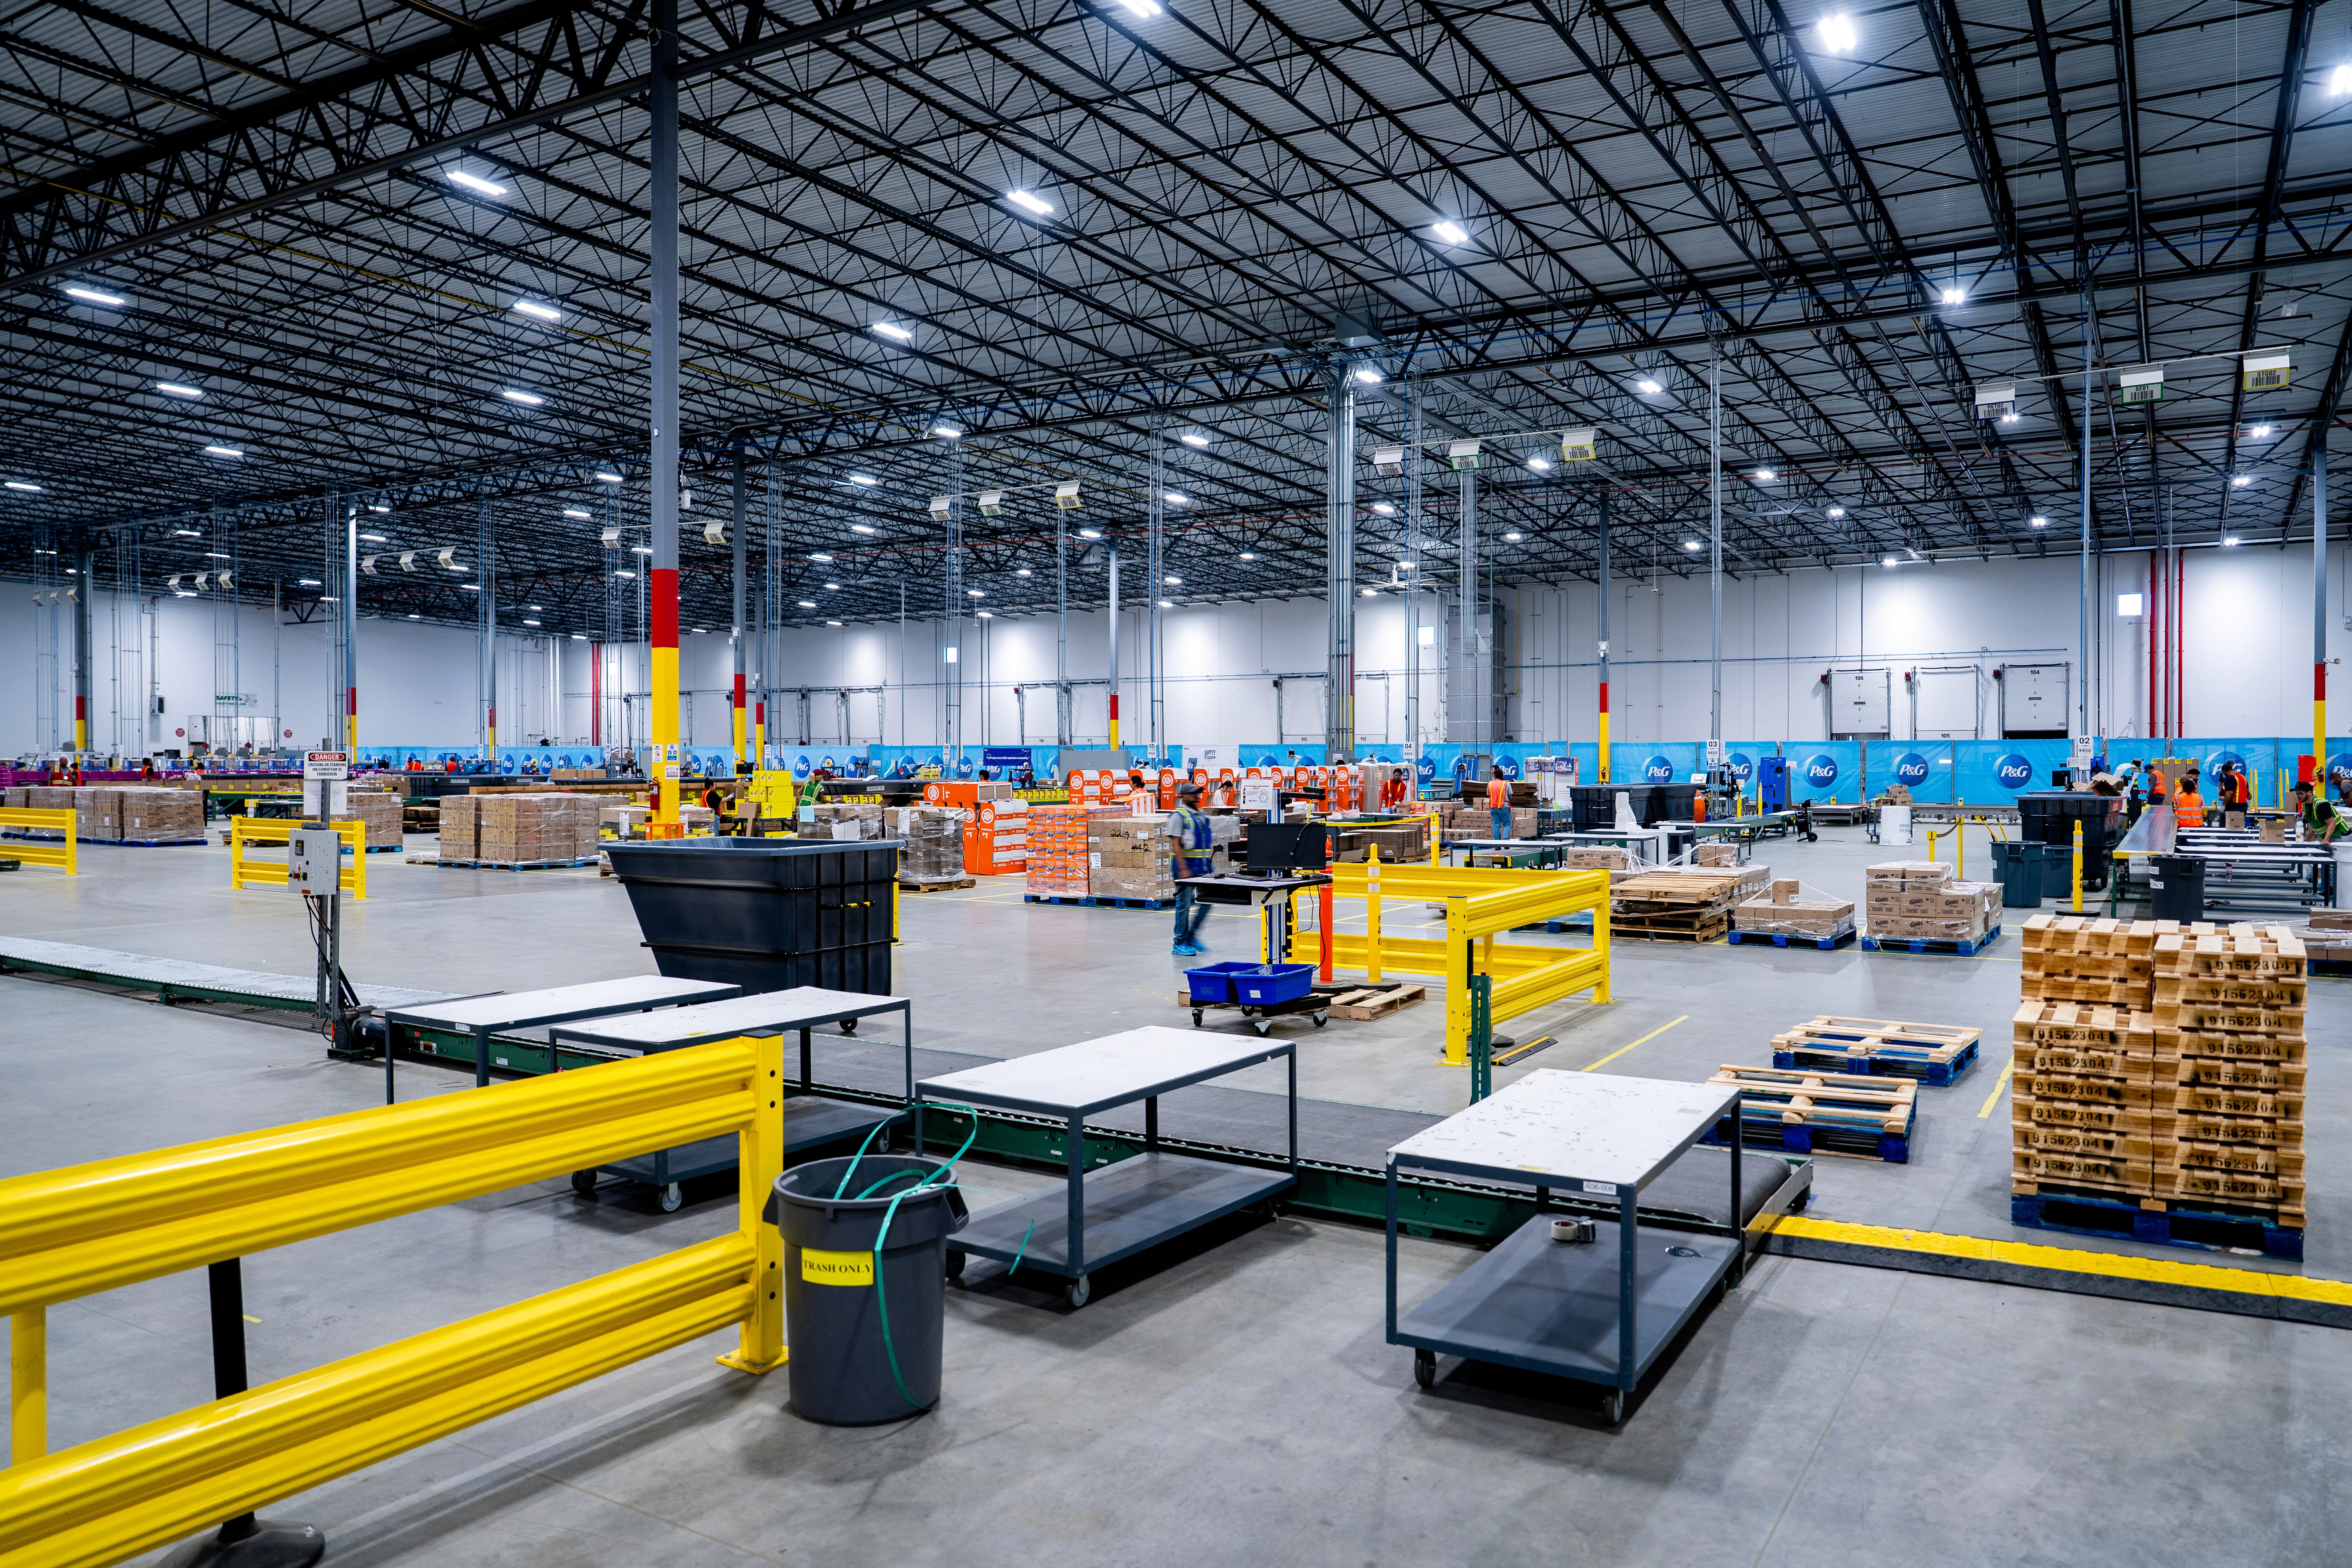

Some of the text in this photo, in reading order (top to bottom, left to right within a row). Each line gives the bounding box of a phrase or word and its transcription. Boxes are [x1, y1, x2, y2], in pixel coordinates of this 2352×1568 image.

[1648, 766, 1670, 777] P&G
[1731, 764, 1749, 774] P&G
[1809, 766, 1834, 777] P&G
[1899, 764, 1925, 775] P&G
[2000, 766, 2028, 777] P&G
[2211, 764, 2242, 775] PG
[2332, 766, 2352, 779] P&
[1072, 777, 1083, 786] Tide
[1102, 777, 1112, 786] Tide
[1163, 777, 1172, 785] Tide
[1196, 776, 1205, 784] Tide
[982, 811, 993, 820] Tide
[1131, 843, 1152, 852] #42
[2216, 960, 2289, 970] 91562304
[2211, 988, 2284, 1000] 91562304
[2209, 1016, 2282, 1027] 91562304
[2038, 1029, 2104, 1041] 91562304
[2208, 1044, 2281, 1056] 91562304
[2039, 1057, 2105, 1069] 91562304
[2205, 1072, 2278, 1084] 91562304
[2036, 1081, 2102, 1096] 91562304
[2205, 1098, 2278, 1112] 91562304
[2036, 1109, 2102, 1122] 91562304
[2203, 1127, 2276, 1140] 91562304
[2033, 1133, 2099, 1147] 91562304
[2034, 1158, 2100, 1174] 91562304
[2196, 1155, 2269, 1171] 91562304
[1585, 1183, 1614, 1192] A06-006
[2203, 1181, 2276, 1193] 91562304
[804, 1259, 873, 1273] TRASH ONLY
